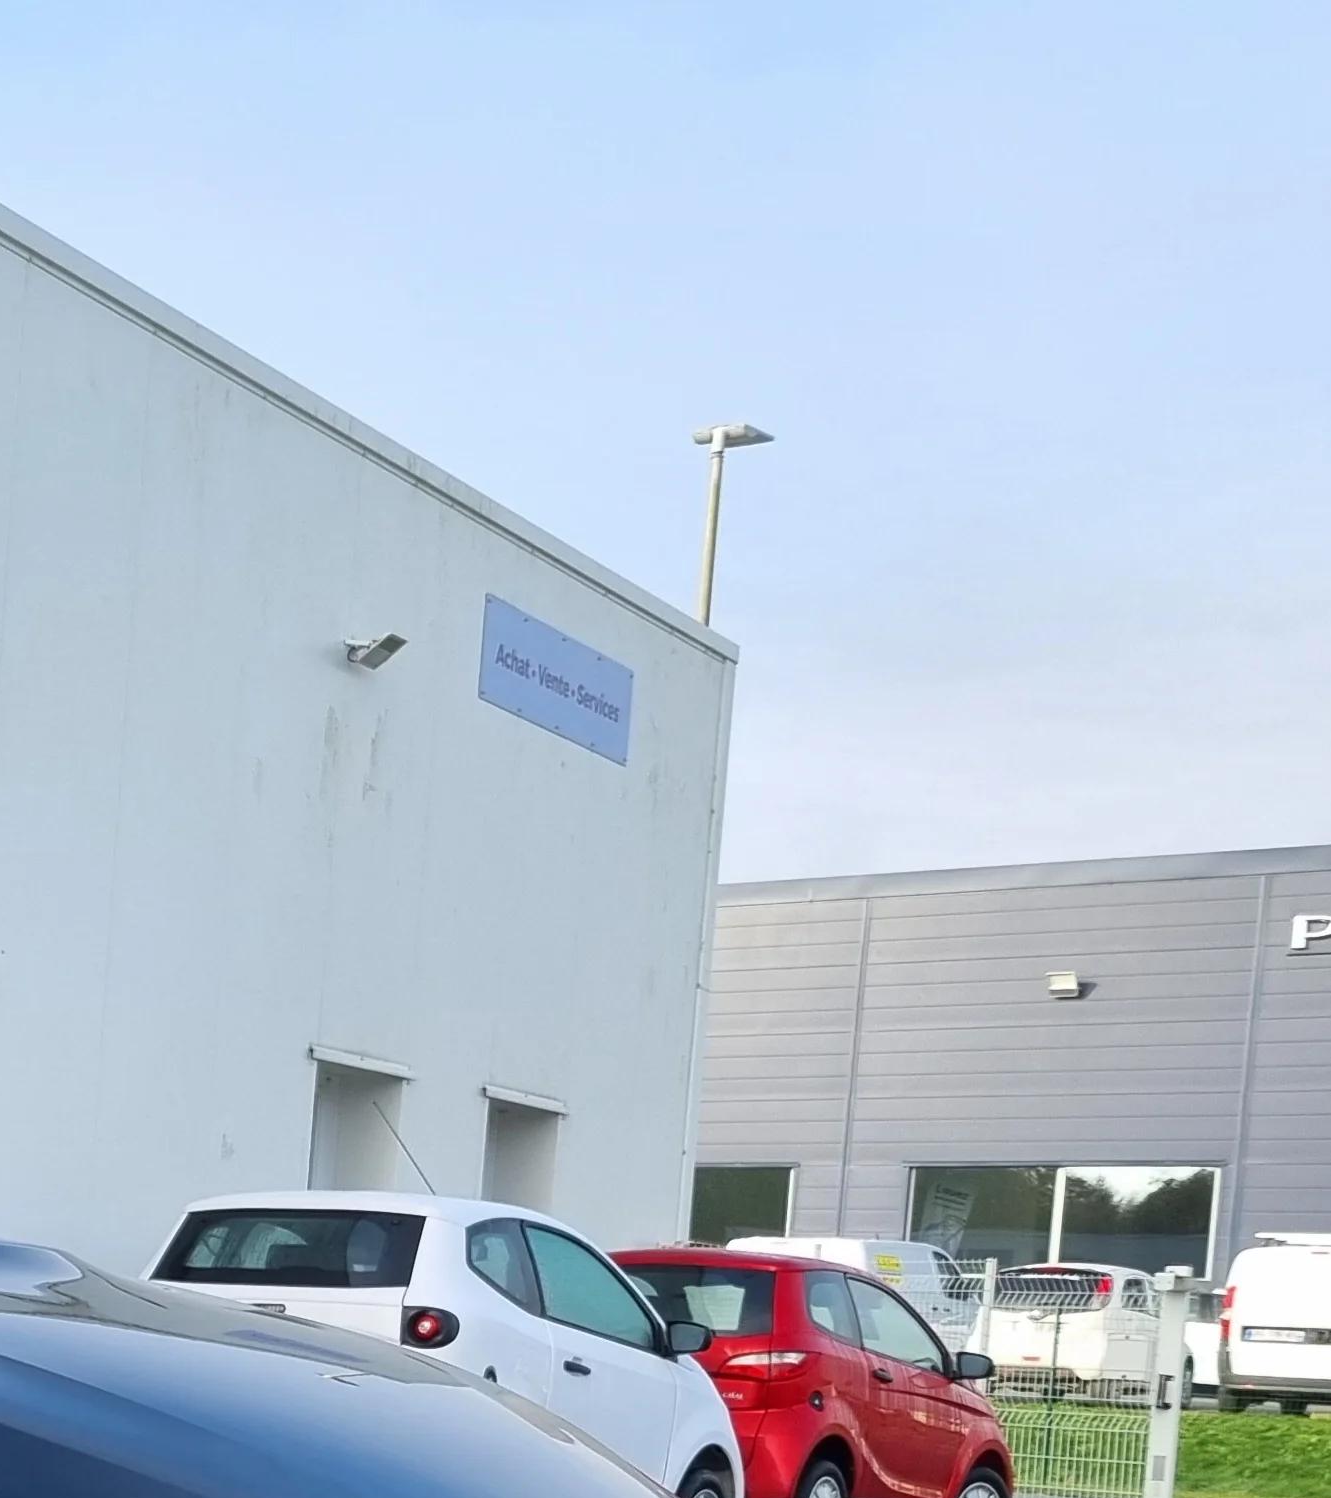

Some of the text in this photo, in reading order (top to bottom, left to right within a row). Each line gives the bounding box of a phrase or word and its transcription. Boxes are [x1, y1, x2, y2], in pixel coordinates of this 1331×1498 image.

[495, 643, 621, 723] Achat Vente Services
